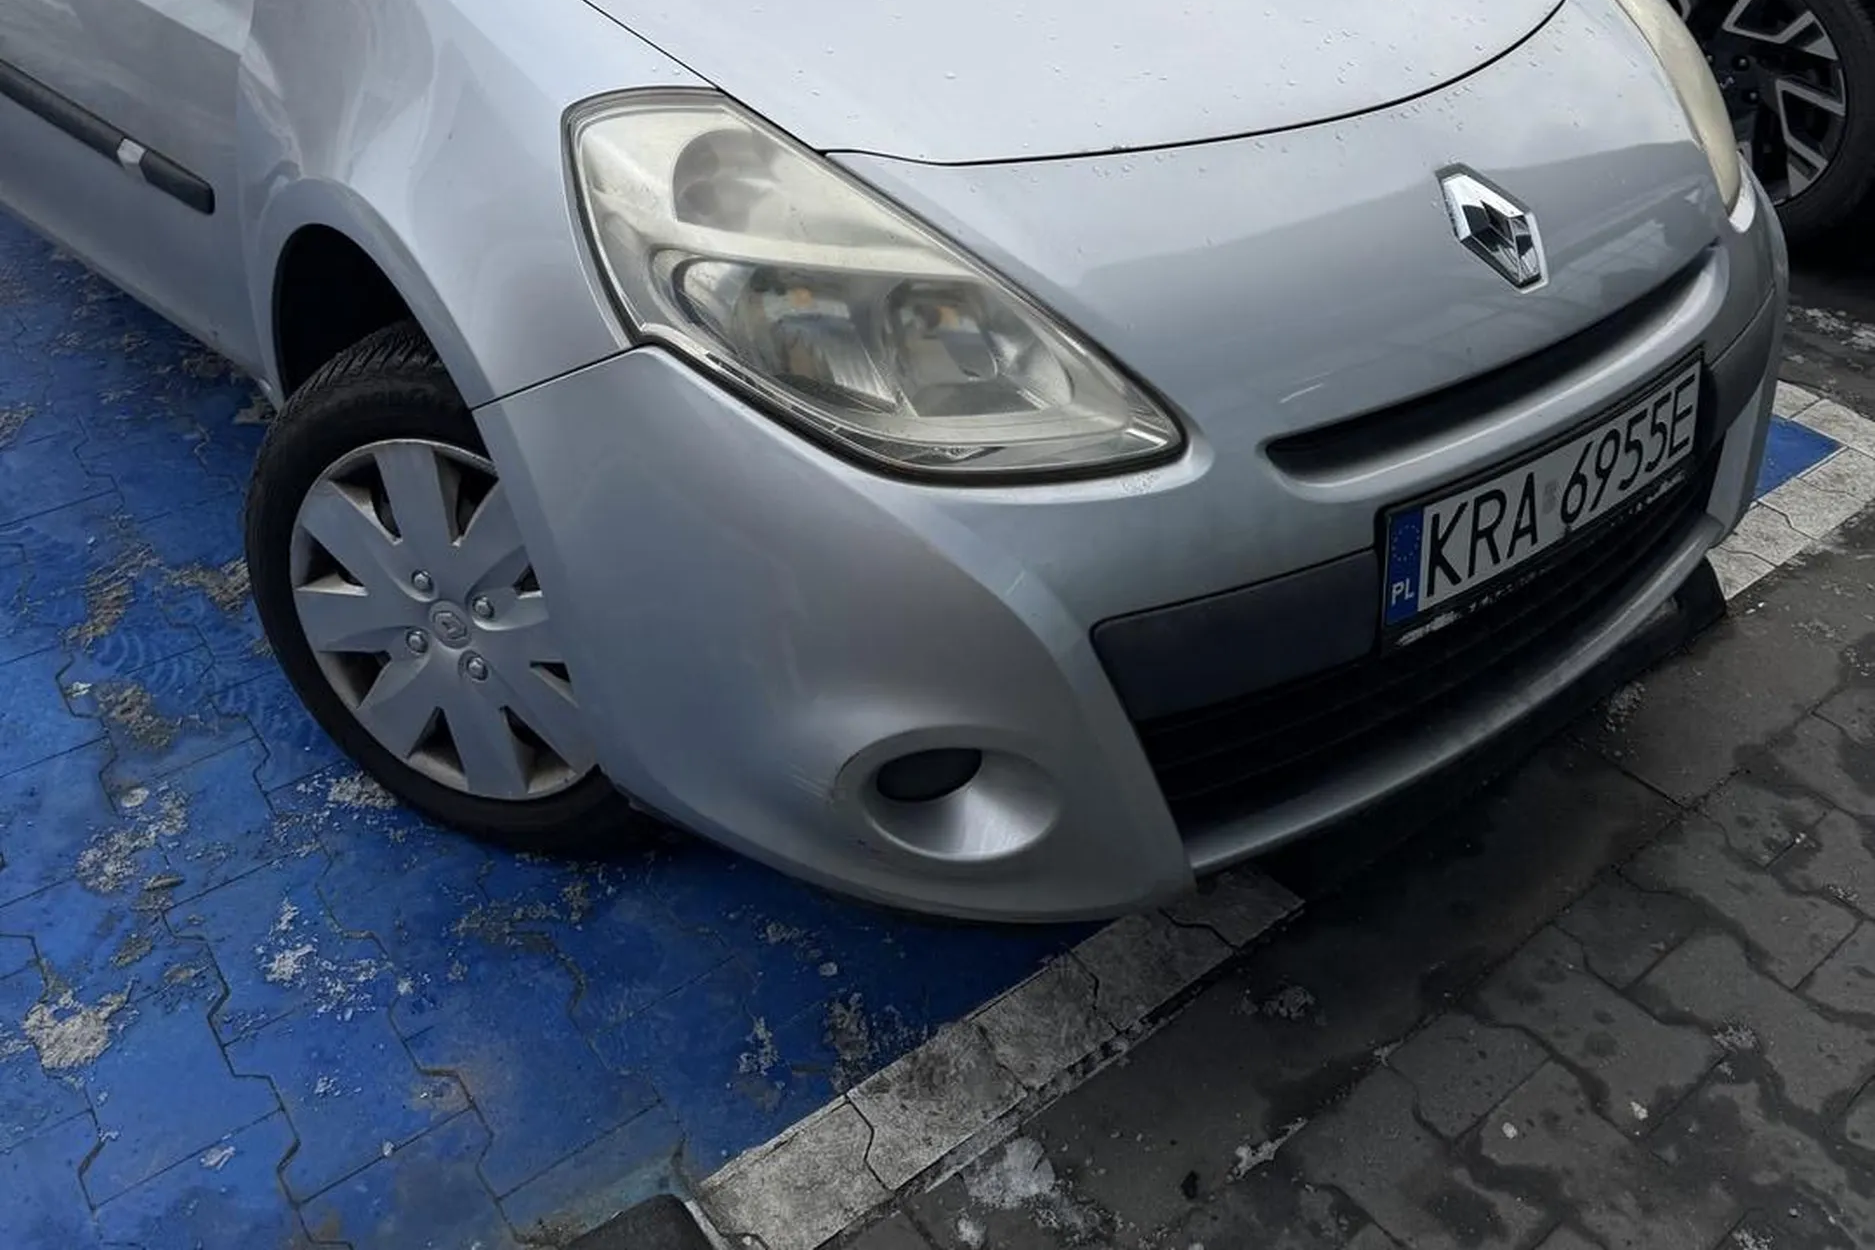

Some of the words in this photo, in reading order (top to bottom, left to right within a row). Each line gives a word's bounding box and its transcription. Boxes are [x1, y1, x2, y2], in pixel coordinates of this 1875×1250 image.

[1425, 472, 1540, 598] KRA
[1560, 374, 1697, 524] 6955E
[1391, 578, 1415, 605] PL
